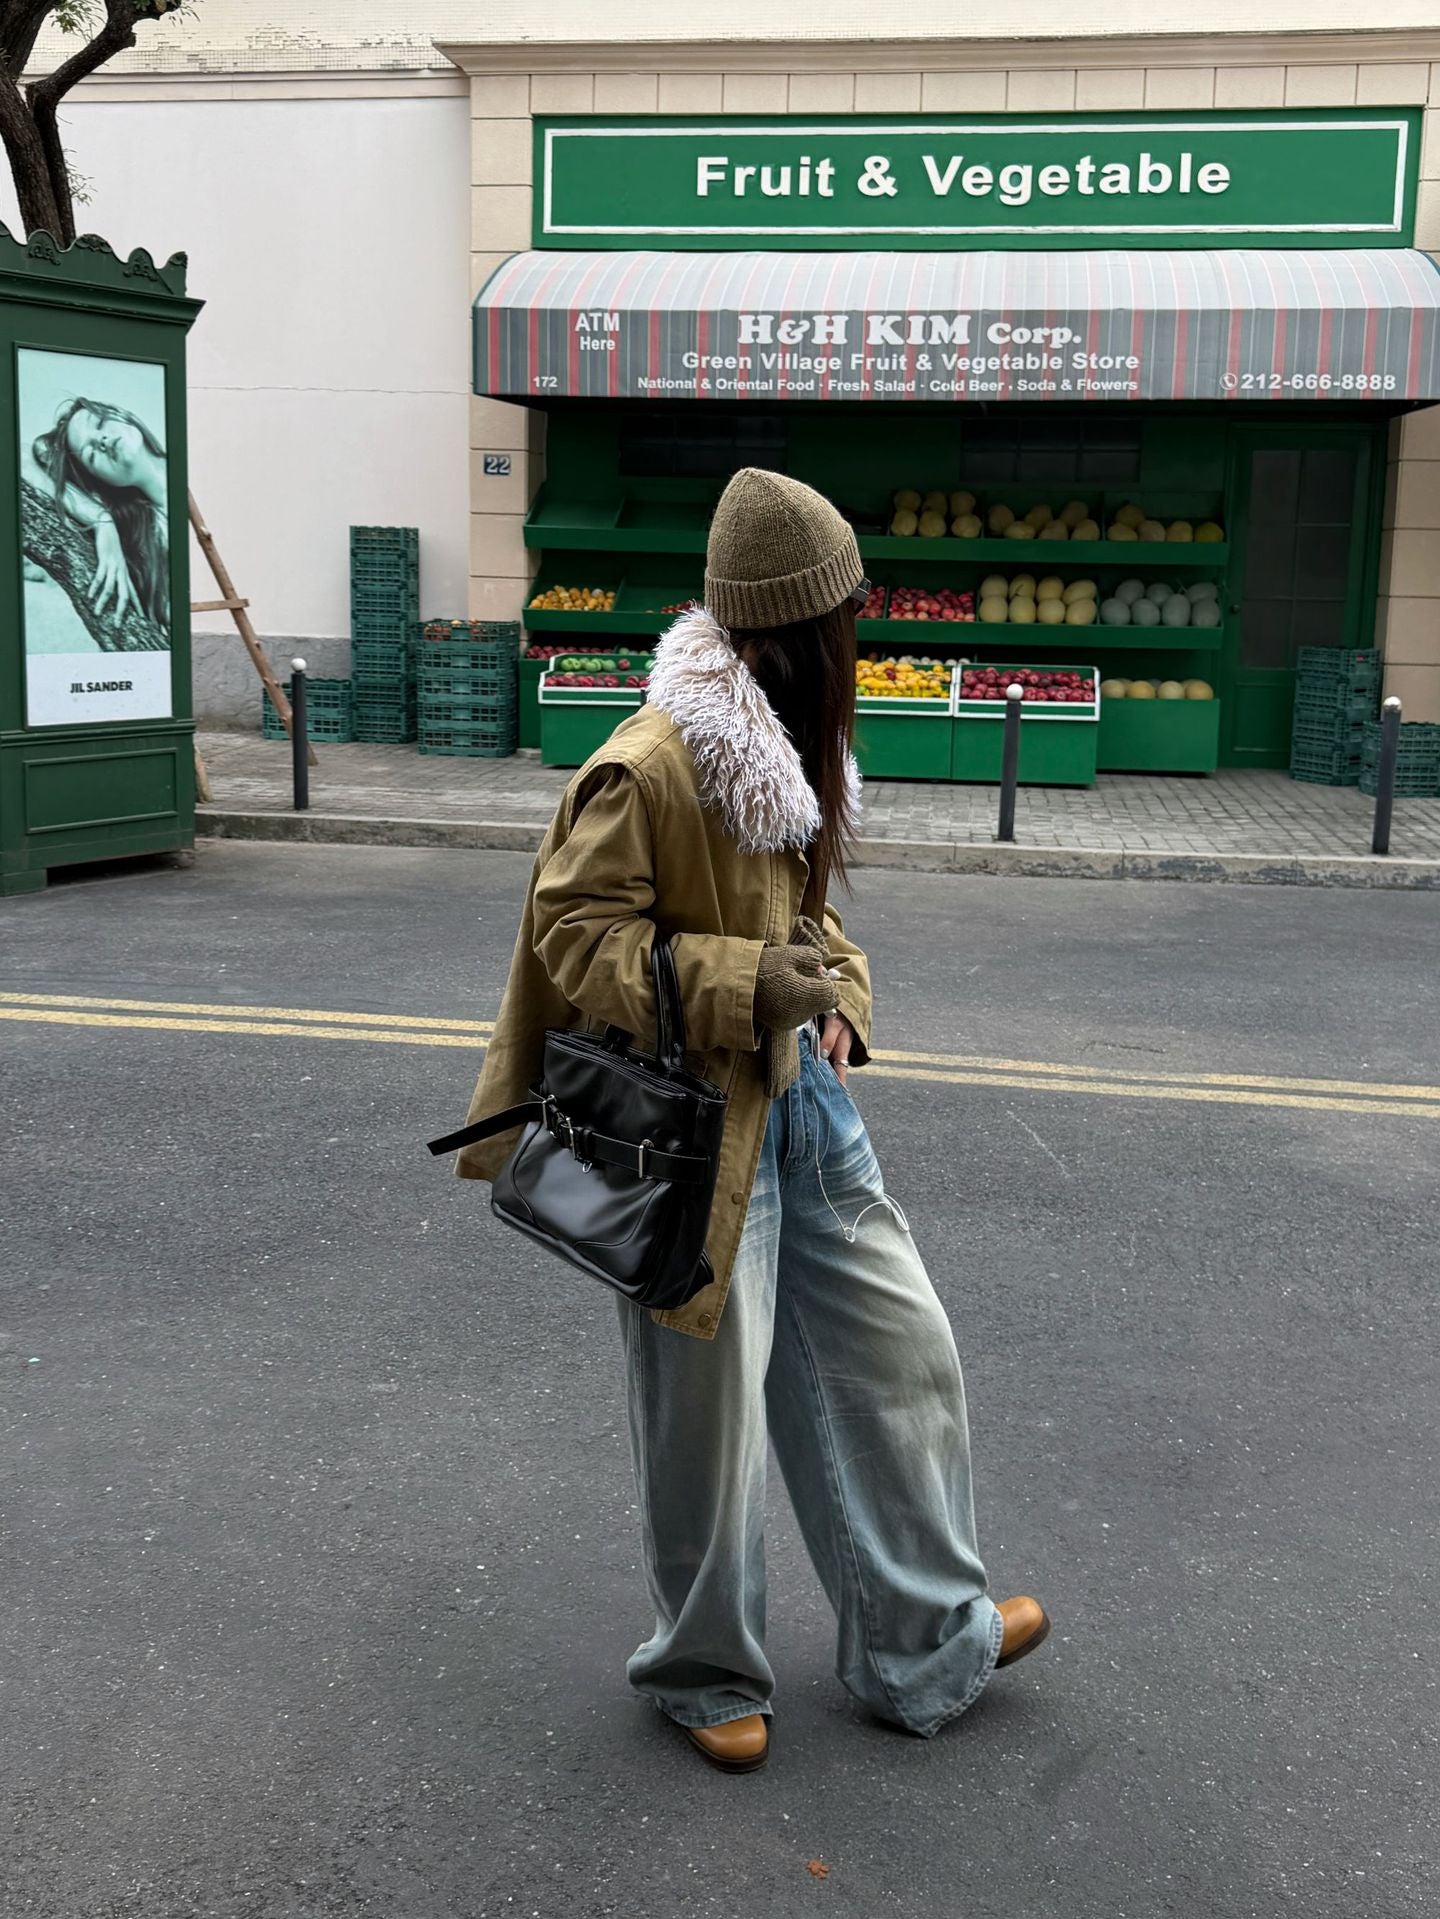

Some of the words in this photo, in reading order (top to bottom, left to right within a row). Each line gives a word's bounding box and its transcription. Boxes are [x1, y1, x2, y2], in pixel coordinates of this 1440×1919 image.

[696, 156, 835, 197] Fruit
[857, 155, 898, 197] &
[921, 152, 1231, 206] Vegetable
[574, 312, 620, 332] ATM
[737, 314, 849, 345] H&H
[865, 315, 972, 345] KIM
[986, 322, 1082, 349] Corp.
[580, 336, 616, 351] Here
[682, 351, 752, 370] Green
[760, 352, 842, 375] Village
[850, 353, 908, 371] Fruit
[915, 353, 933, 371] &
[941, 352, 1063, 375] Vegetable
[1071, 352, 1140, 370] Store
[533, 376, 558, 388] 172
[637, 377, 697, 390] National
[700, 378, 711, 391] &
[715, 378, 773, 391] Oriental
[777, 378, 815, 391] Food
[828, 379, 870, 392] Fresh
[873, 379, 916, 392] Salad
[929, 379, 965, 392] Cold
[968, 380, 1005, 392] Beer
[1016, 378, 1057, 391] Soda
[1060, 379, 1073, 391] &
[1076, 378, 1138, 391] Flowers
[1240, 373, 1396, 391] 212-666-8888
[486, 456, 510, 473] 22
[70, 683, 85, 693] JIL
[86, 681, 133, 693] SANDER
